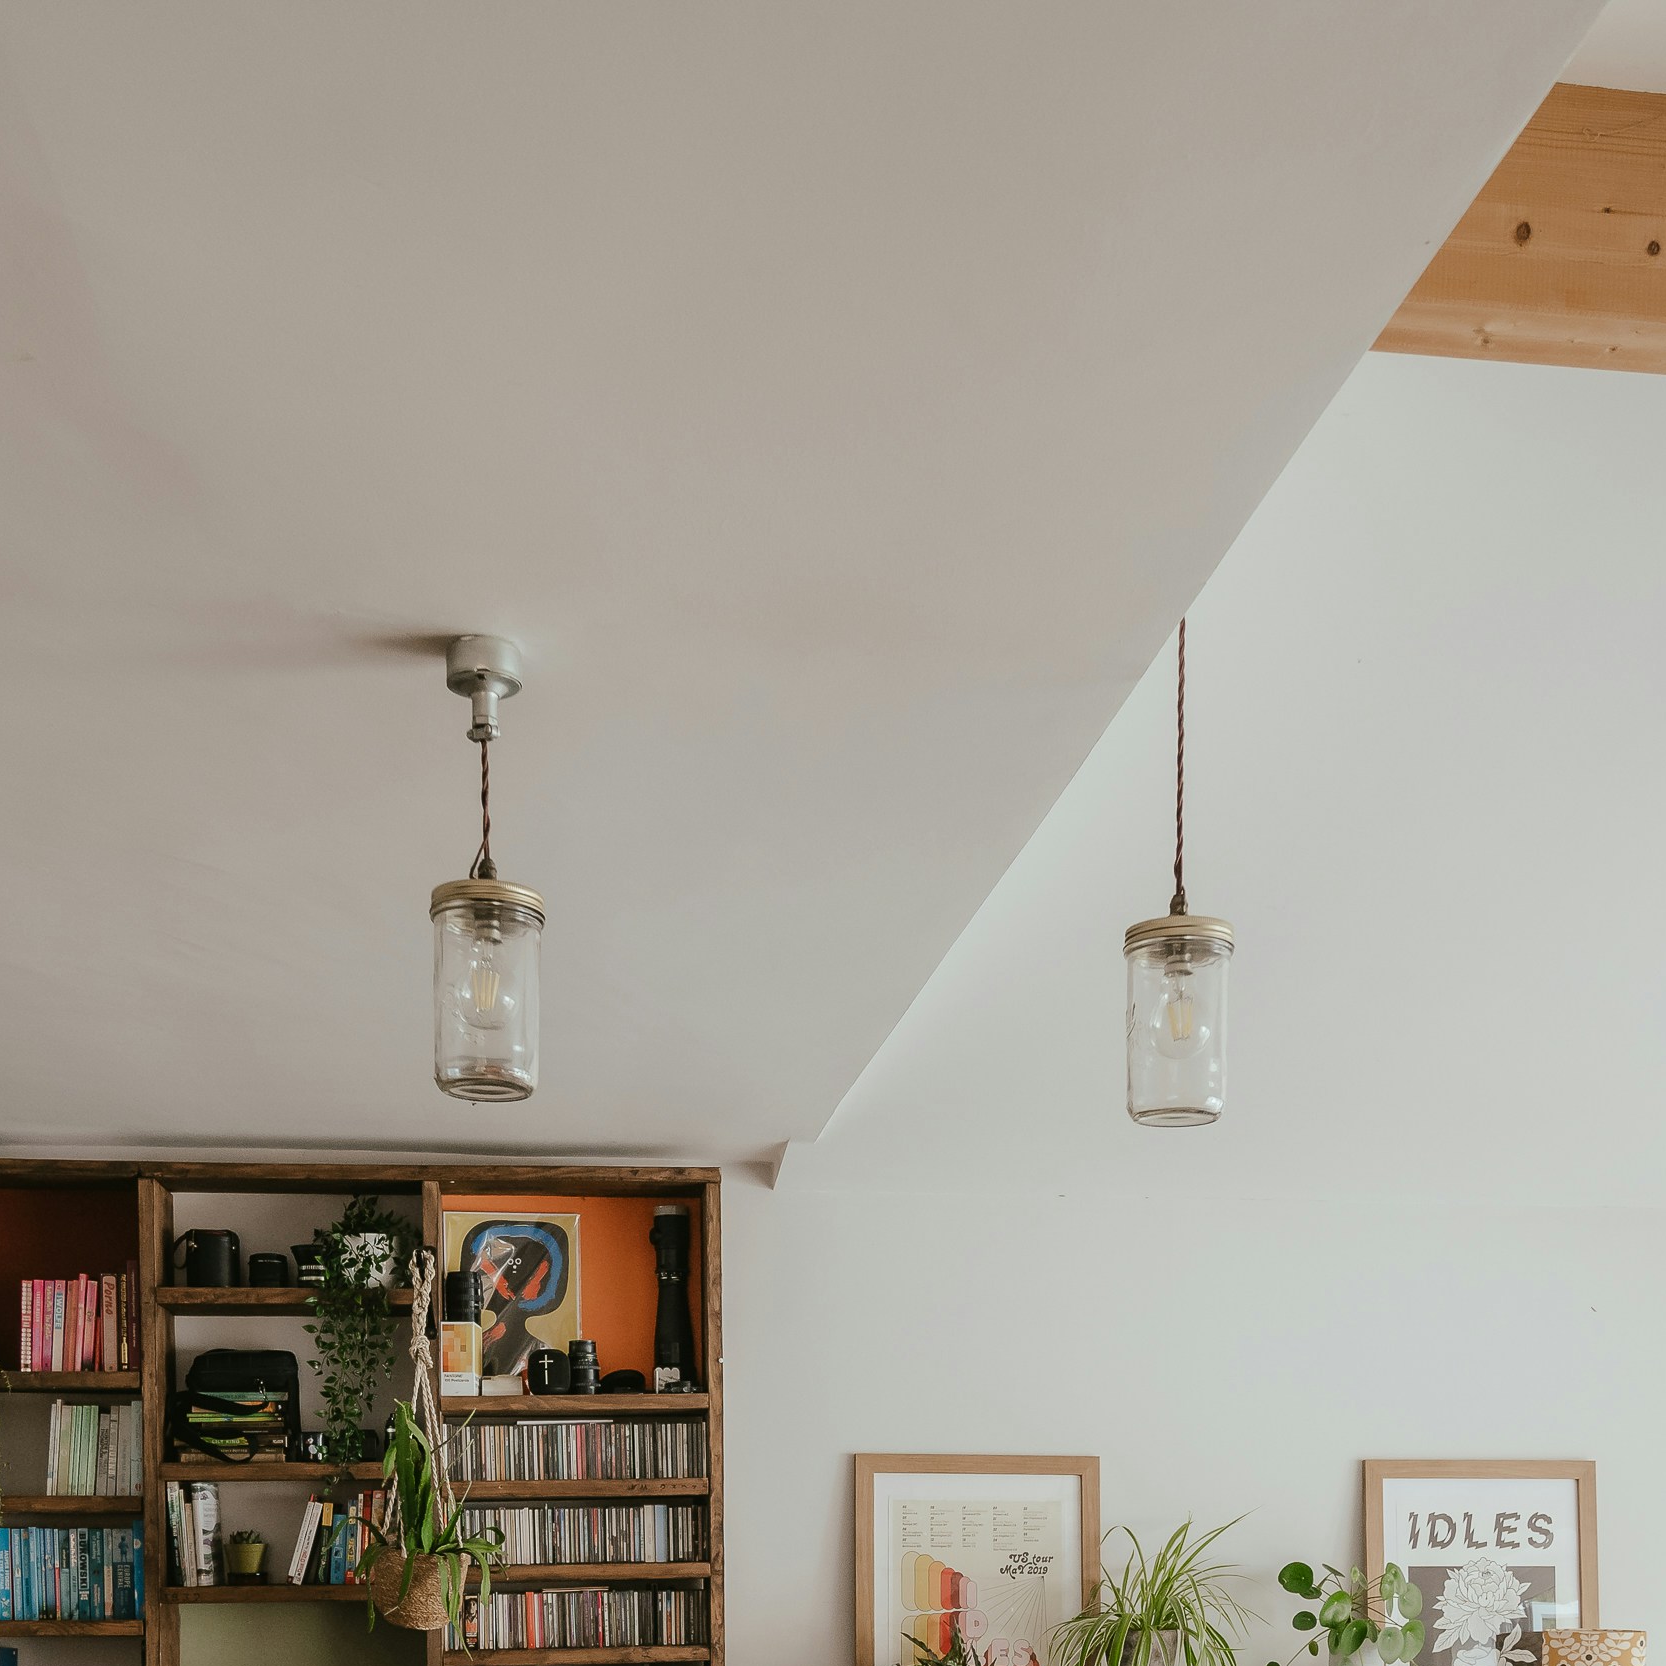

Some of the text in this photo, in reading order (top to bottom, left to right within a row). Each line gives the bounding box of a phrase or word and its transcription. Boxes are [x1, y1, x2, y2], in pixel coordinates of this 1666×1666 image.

[105, 1282, 115, 1315] Porno
[1408, 1512, 1554, 1550] IDLES
[79, 1533, 88, 1589] BUKOWSKI
[1009, 1552, 1053, 1565] US tour
[1027, 1565, 1048, 1575] 2019
